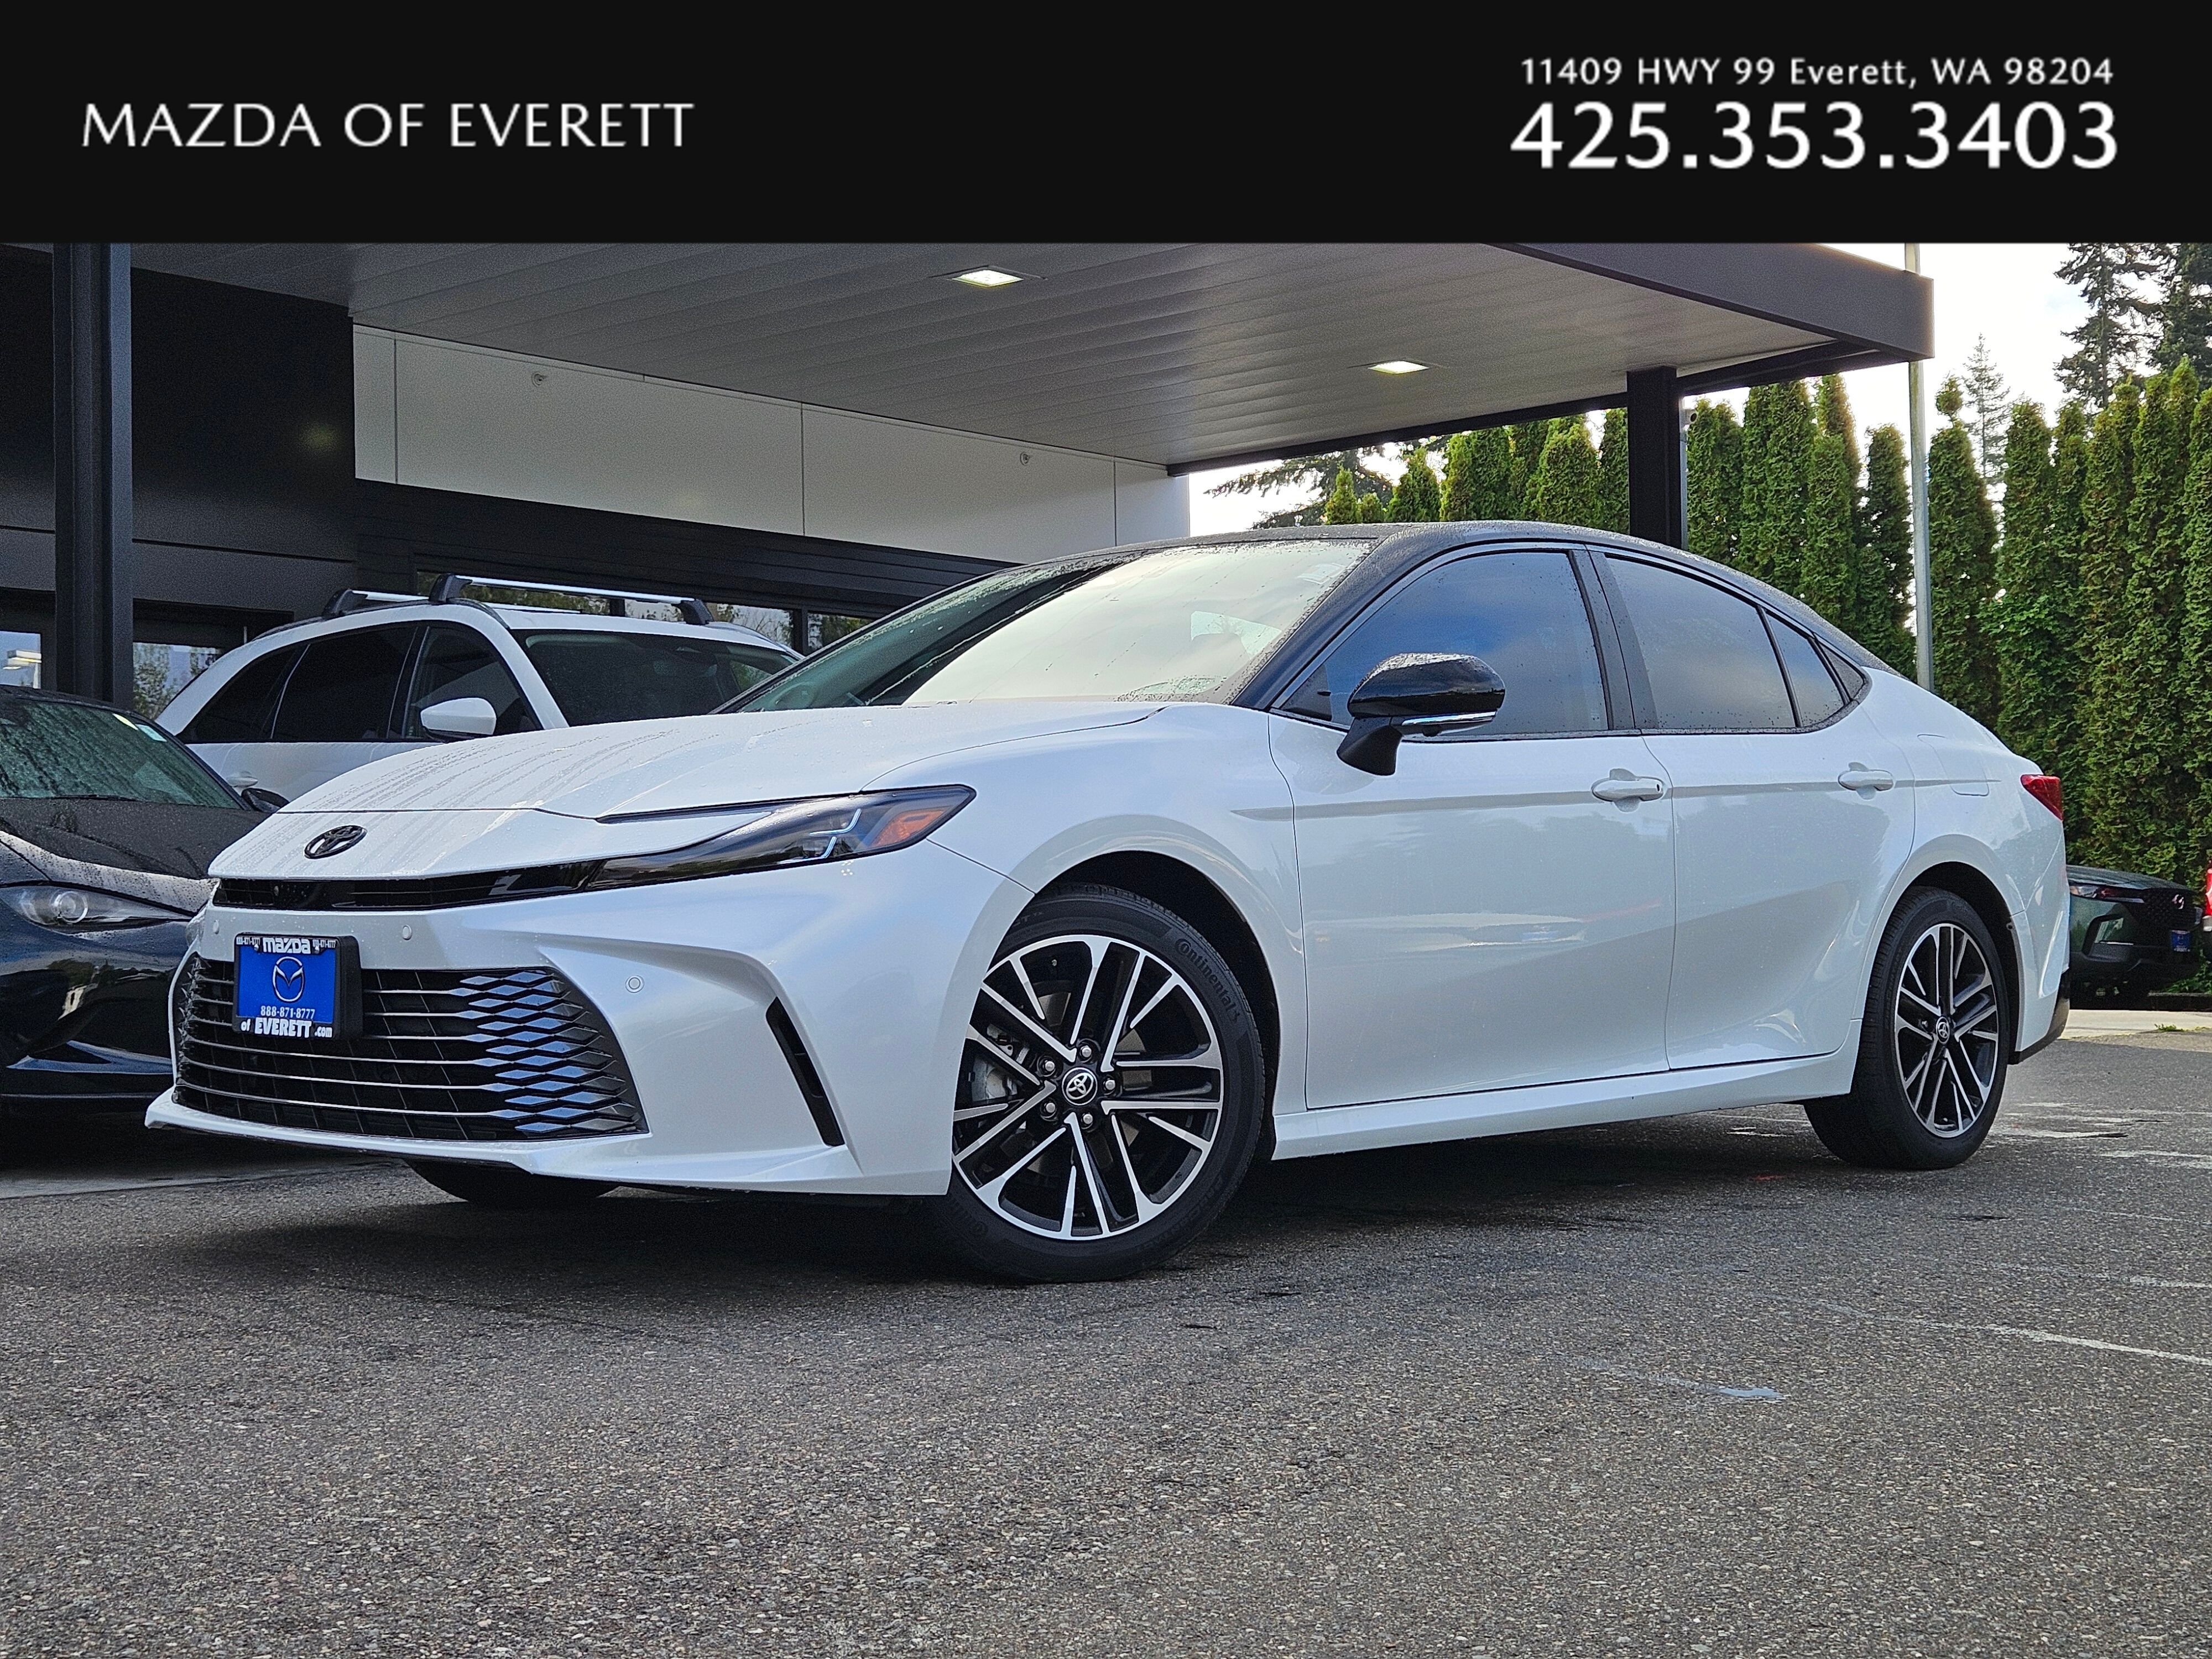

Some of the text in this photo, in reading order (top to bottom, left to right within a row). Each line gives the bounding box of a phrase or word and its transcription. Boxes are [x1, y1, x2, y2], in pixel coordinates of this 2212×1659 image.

[1175, 938, 1237, 1022] Continental
[260, 1005, 315, 1019] 888-871-8777
[241, 1017, 333, 1038] of EVERETT .com
